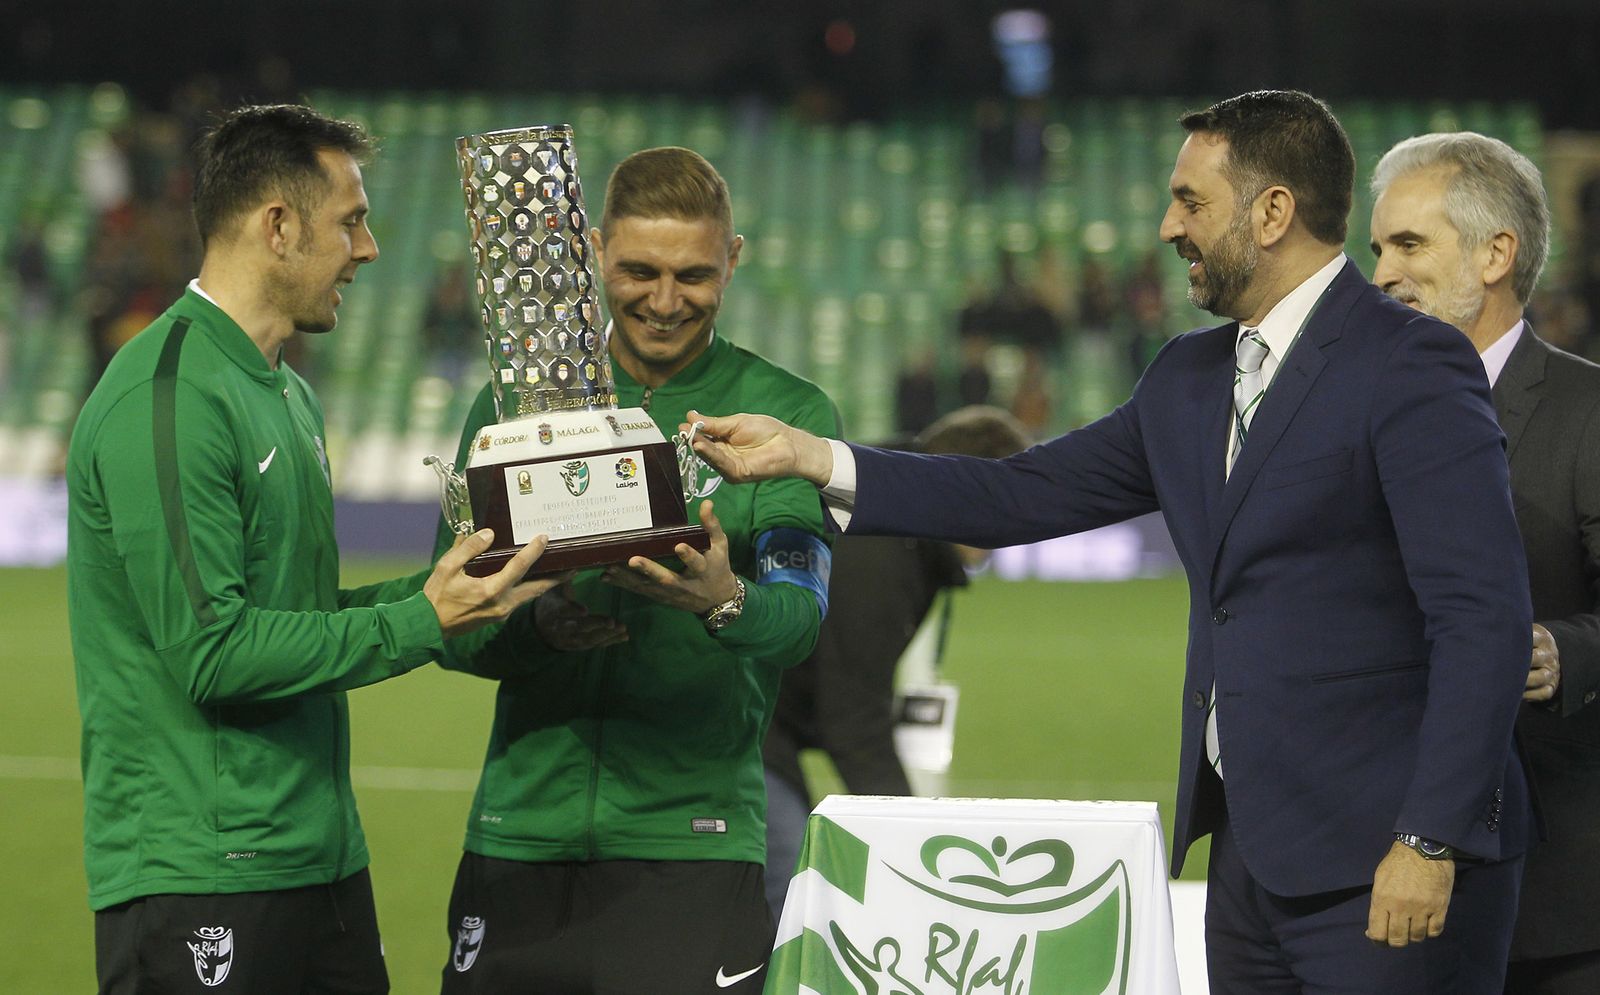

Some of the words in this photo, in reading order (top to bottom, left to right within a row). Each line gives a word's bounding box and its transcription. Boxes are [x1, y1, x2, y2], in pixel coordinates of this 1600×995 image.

[556, 425, 600, 438] MÁLAGA
[615, 481, 638, 489] LaLiga
[757, 548, 816, 574] nicef
